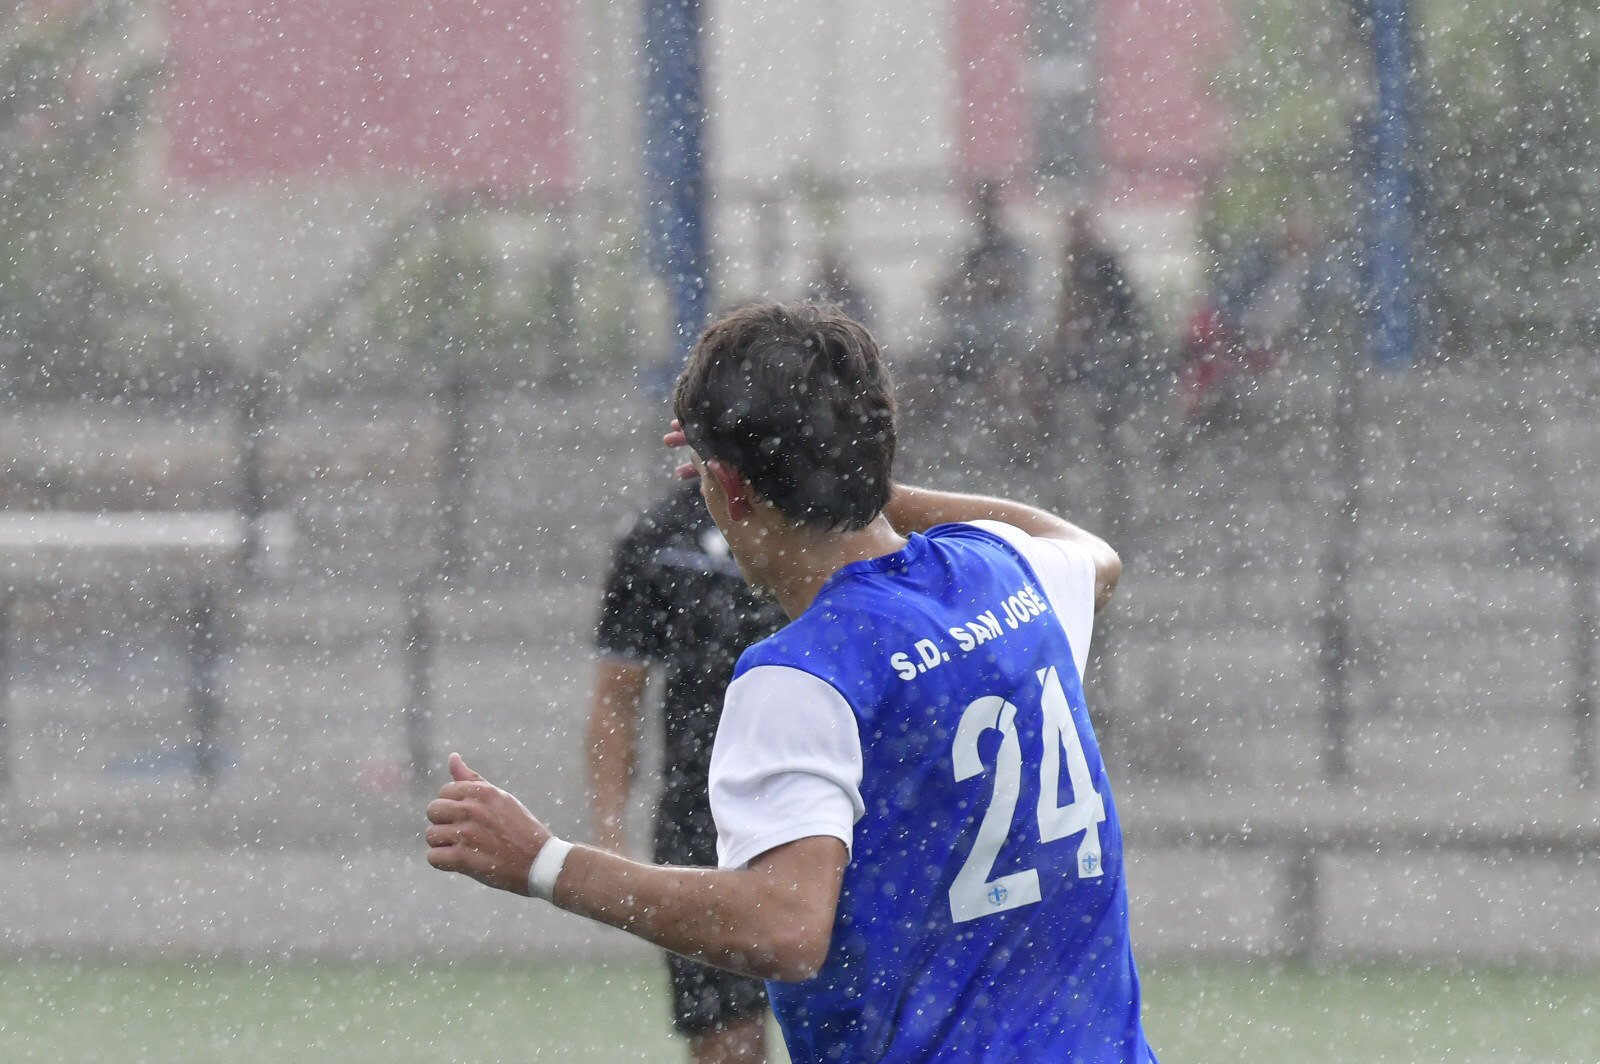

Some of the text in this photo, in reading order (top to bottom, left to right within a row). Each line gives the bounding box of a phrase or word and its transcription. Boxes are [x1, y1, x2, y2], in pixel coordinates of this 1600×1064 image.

[890, 638, 950, 681] S.D.
[949, 609, 1004, 652] SAN
[948, 665, 1106, 924] 24
